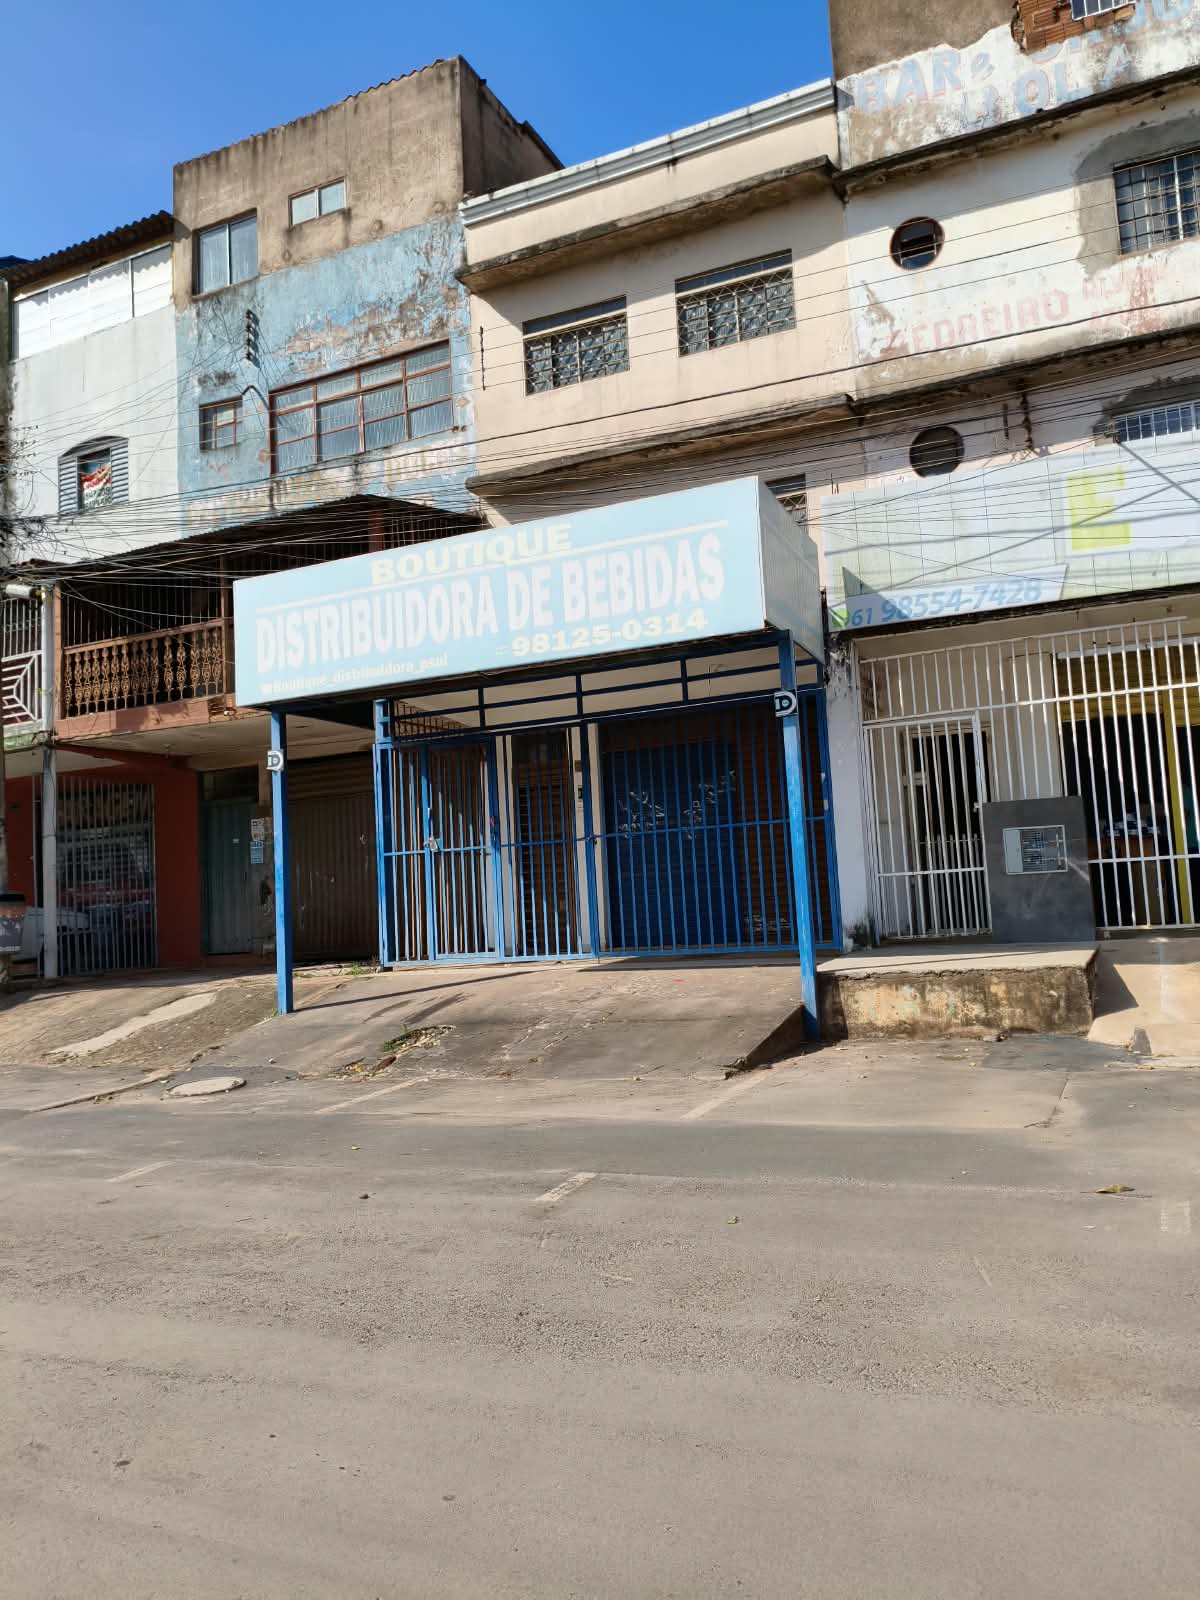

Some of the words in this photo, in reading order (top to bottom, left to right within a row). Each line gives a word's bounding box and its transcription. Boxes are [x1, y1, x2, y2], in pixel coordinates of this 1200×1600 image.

[857, 47, 961, 112] BAR
[370, 523, 573, 586] BOUTIQUE
[256, 573, 499, 673] DISTRIBUIDORA
[504, 563, 553, 633] DE
[562, 533, 726, 623] BEBIDAS
[512, 608, 709, 657] 98125-0314
[851, 606, 873, 627] 61
